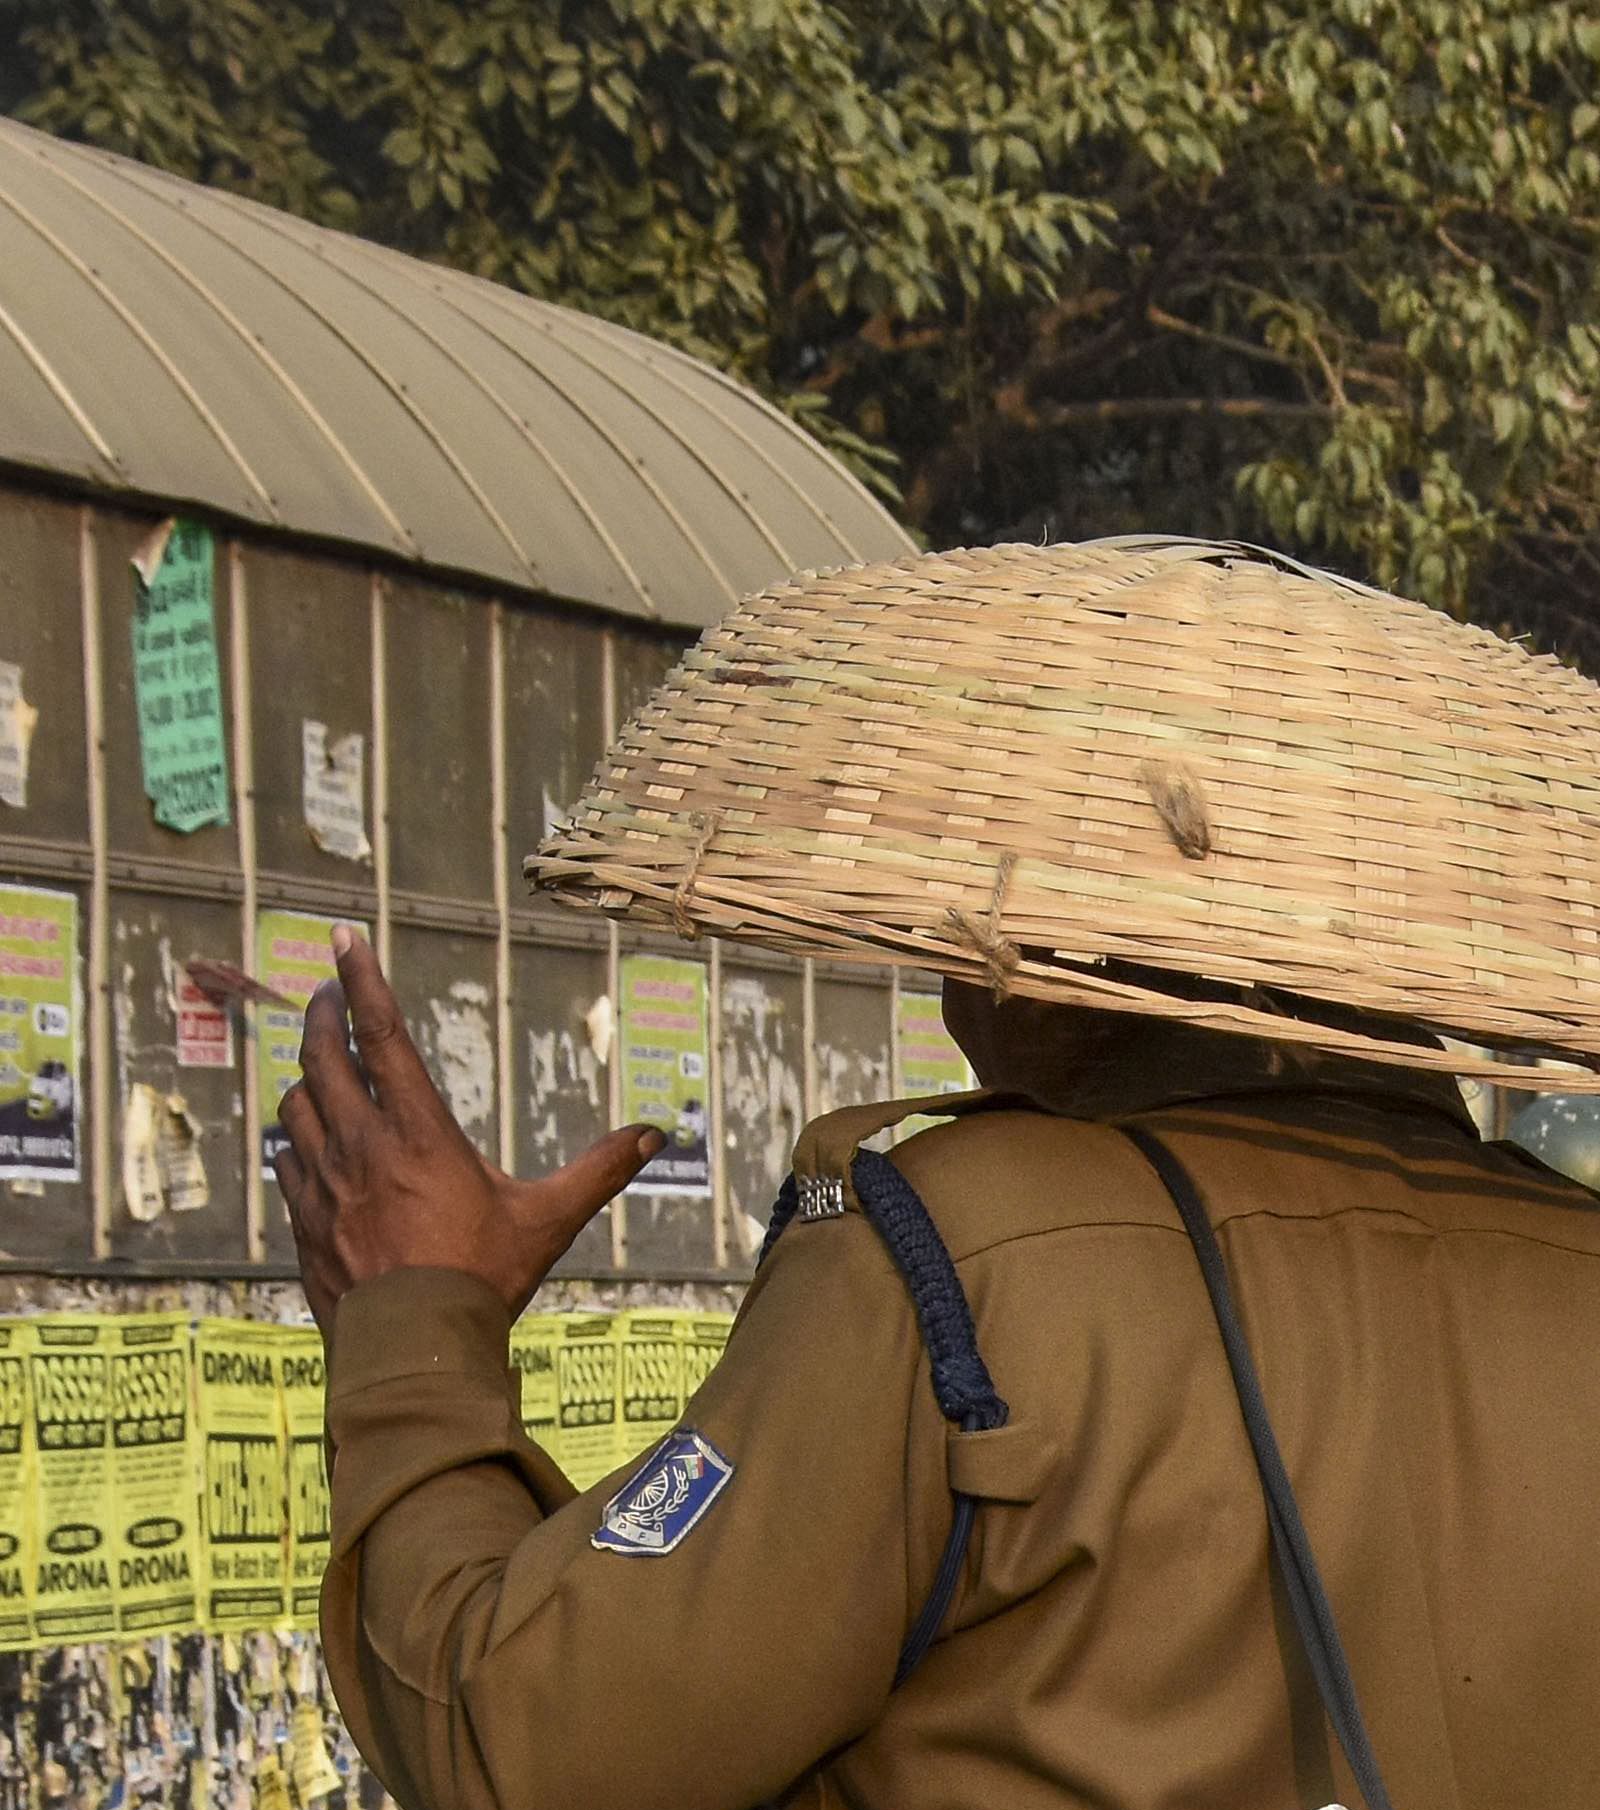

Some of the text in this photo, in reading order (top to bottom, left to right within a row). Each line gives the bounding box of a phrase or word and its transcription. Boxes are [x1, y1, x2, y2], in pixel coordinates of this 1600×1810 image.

[203, 1352, 274, 1386] DRONA
[282, 1352, 324, 1387] DRO
[119, 1552, 190, 1588] DRONA
